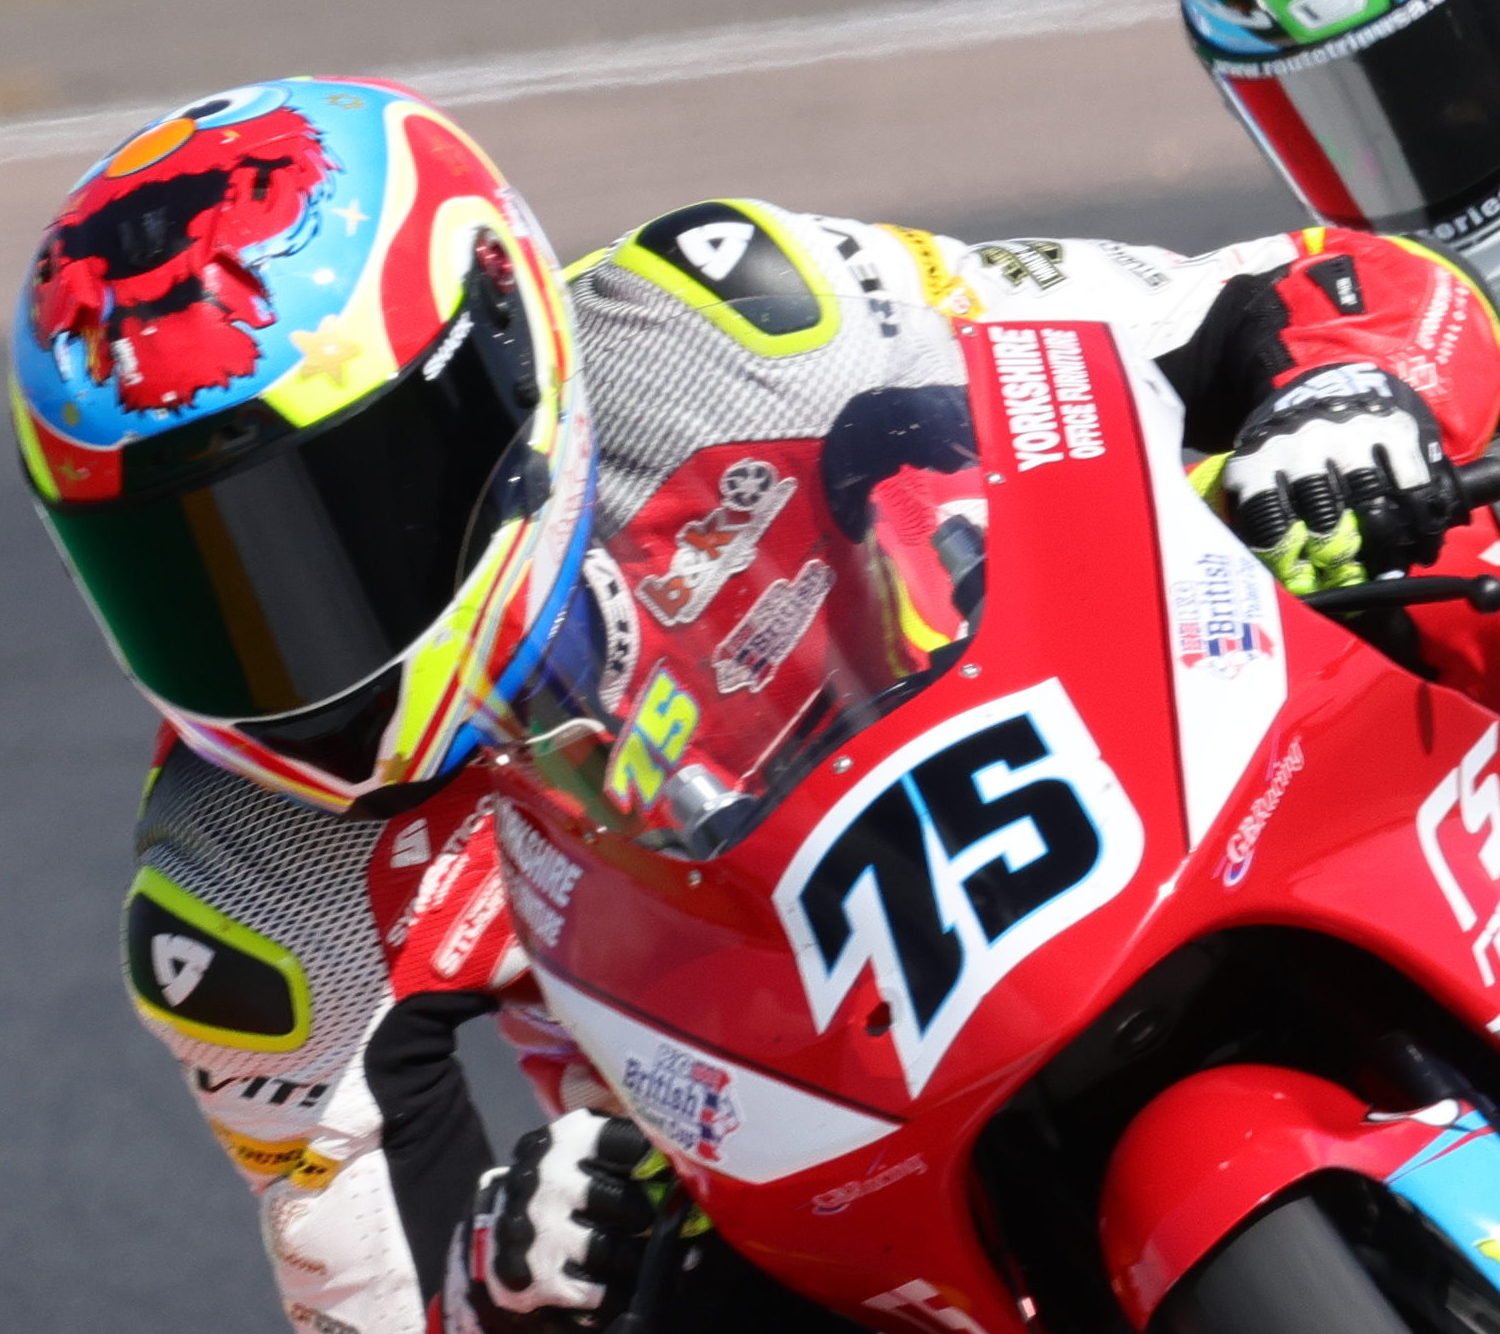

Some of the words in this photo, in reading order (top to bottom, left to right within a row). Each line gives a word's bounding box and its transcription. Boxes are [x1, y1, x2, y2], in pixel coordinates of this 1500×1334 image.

[987, 326, 1065, 472] YORKSHIRE
[1040, 328, 1094, 402] FURNITURE
[1060, 403, 1106, 459] OFFICE
[1195, 553, 1235, 635] British
[611, 668, 700, 814] 75
[799, 711, 1104, 1038] 75
